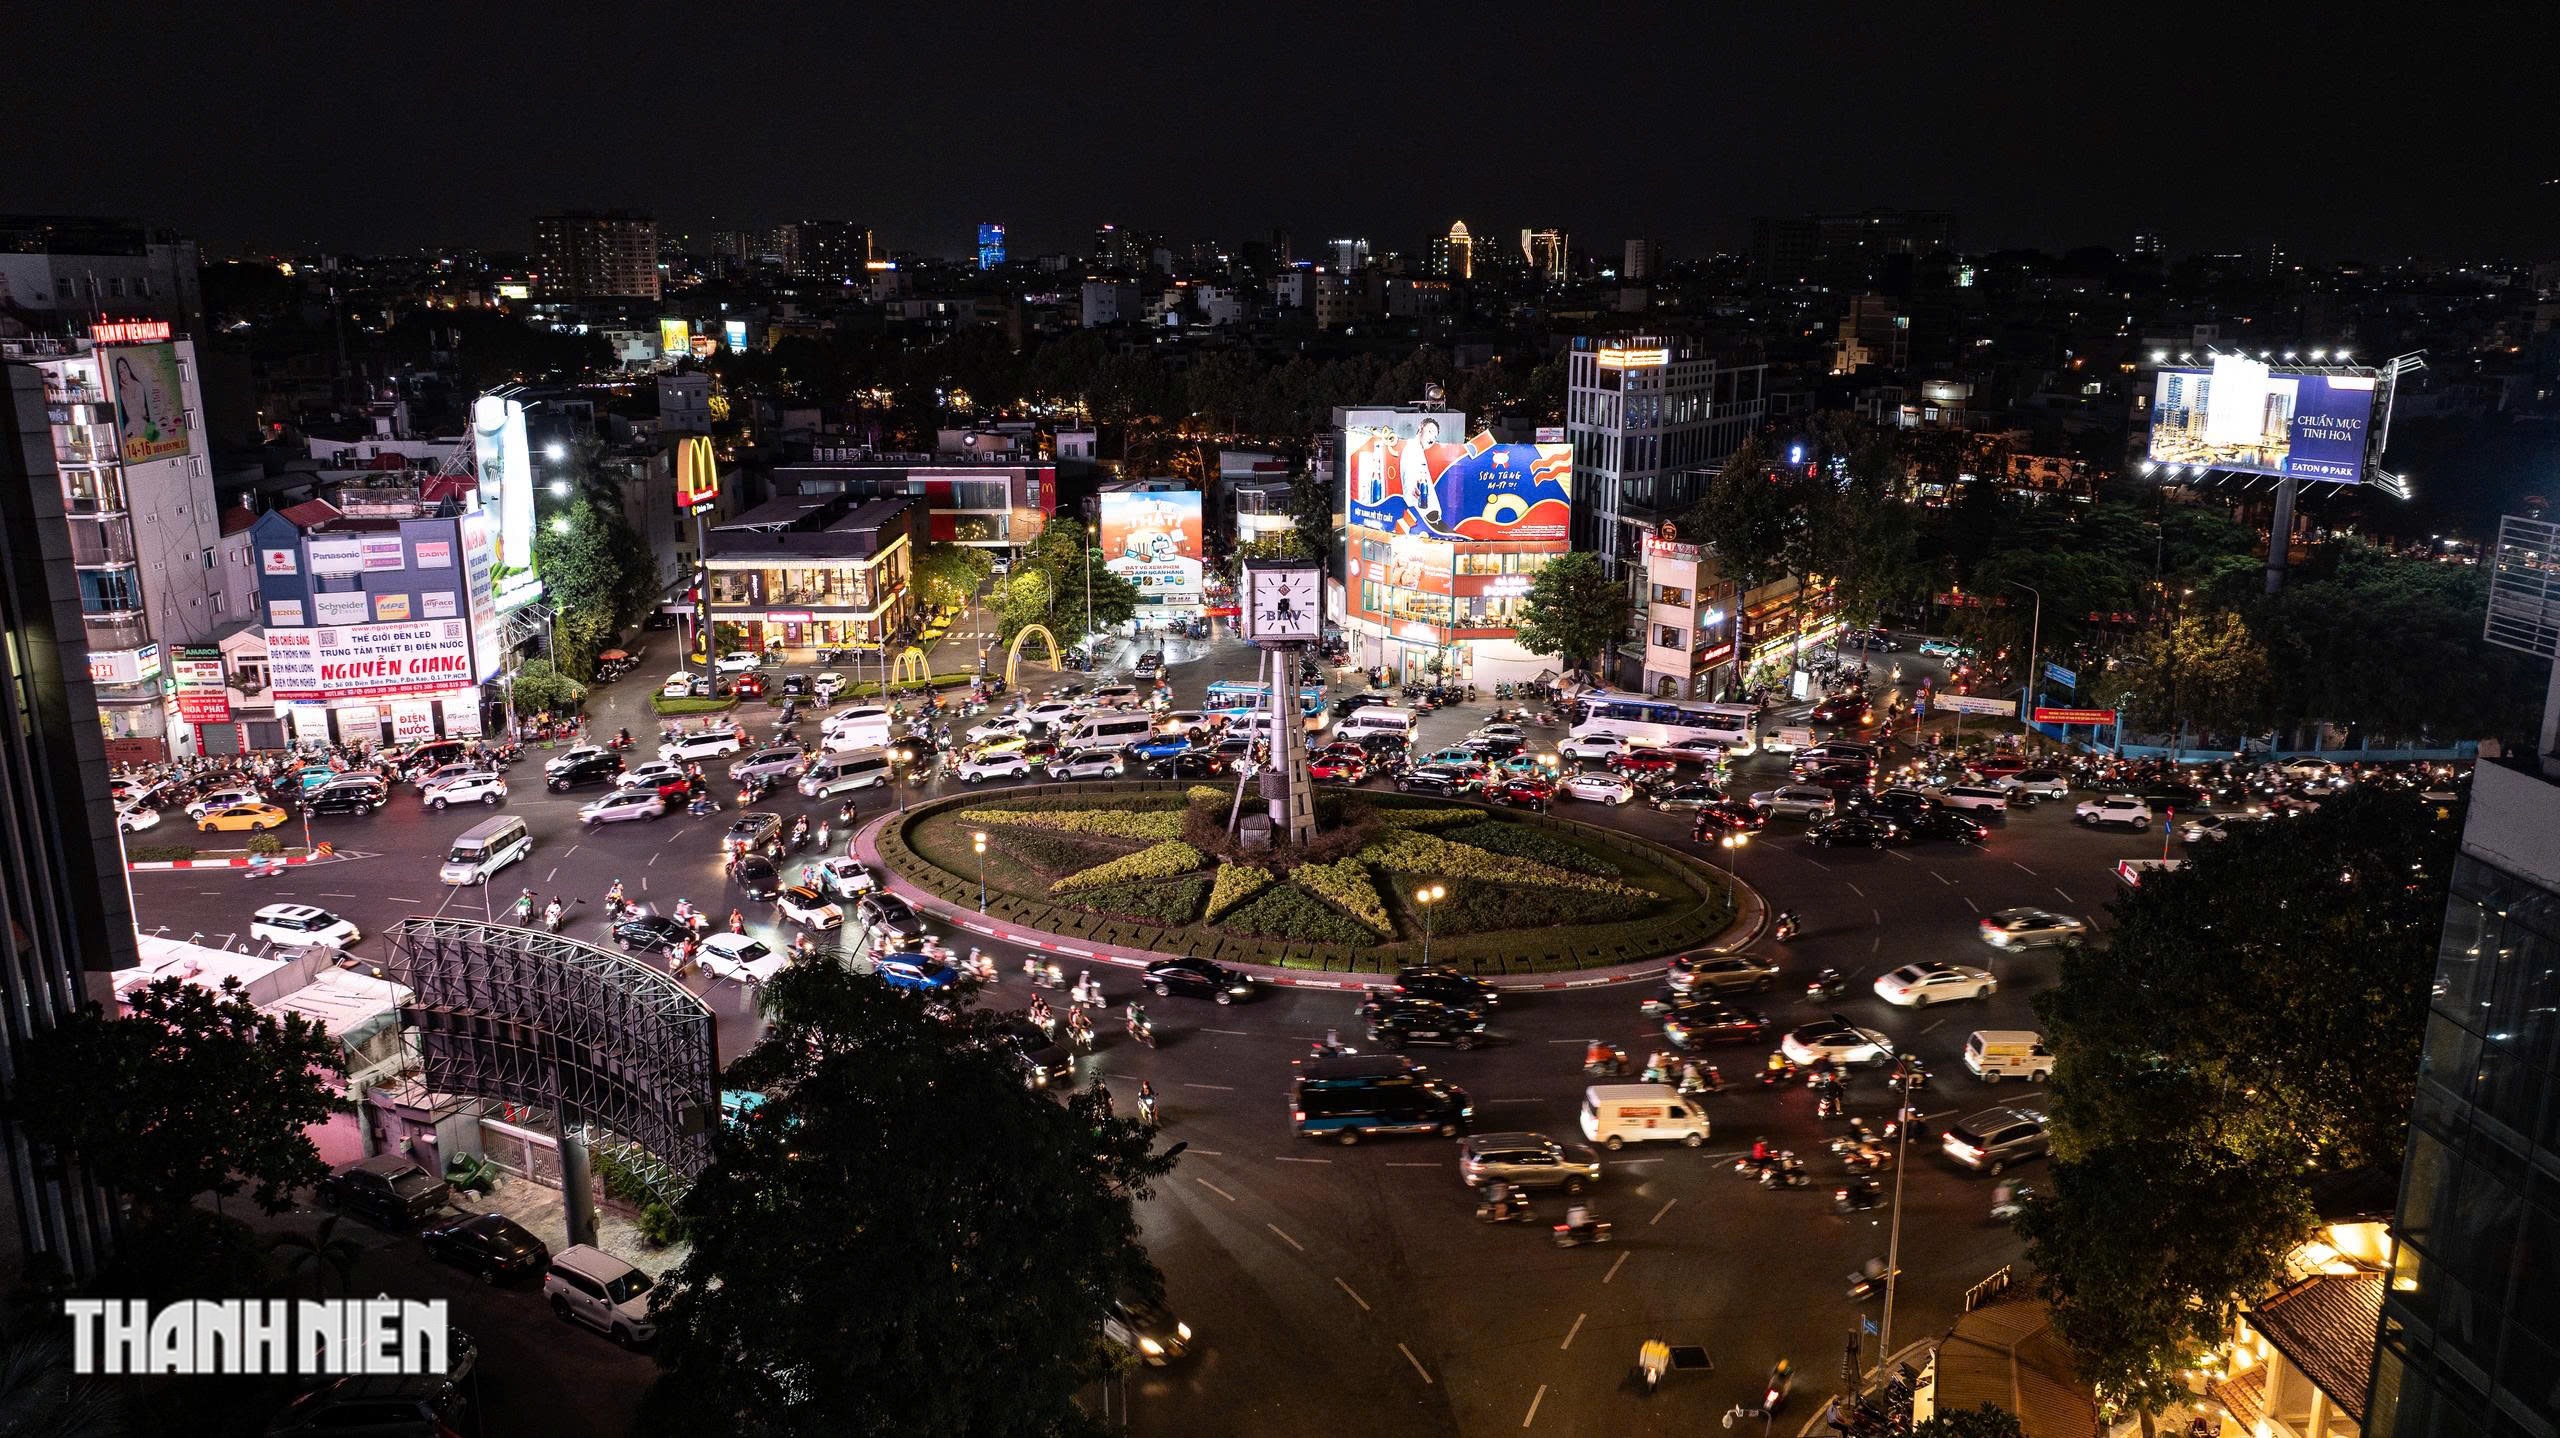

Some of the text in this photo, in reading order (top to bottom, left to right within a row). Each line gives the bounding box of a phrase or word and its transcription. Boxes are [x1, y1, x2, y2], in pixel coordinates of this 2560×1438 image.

[2298, 414, 2361, 430] CHUẨN MỰC
[2302, 428, 2351, 441] TINH HOA
[126, 441, 151, 458] 14-16
[2292, 462, 2352, 475] EATON PARK
[312, 550, 360, 561] Panasonic
[318, 601, 364, 612] Schneider
[379, 602, 405, 610] MPE
[351, 622, 429, 632] www.nguyengiang.vn
[352, 630, 431, 643] THẾ GIỚI ĐÈN LED
[186, 648, 219, 656] AMARON
[320, 639, 464, 657] TRUNG TÂM THIẾT BỊ ĐIỆN NƯỚC
[321, 655, 466, 680] NGUYỄN GIANG
[399, 713, 426, 725] ĐIỆN
[399, 724, 430, 736] NƯỚC
